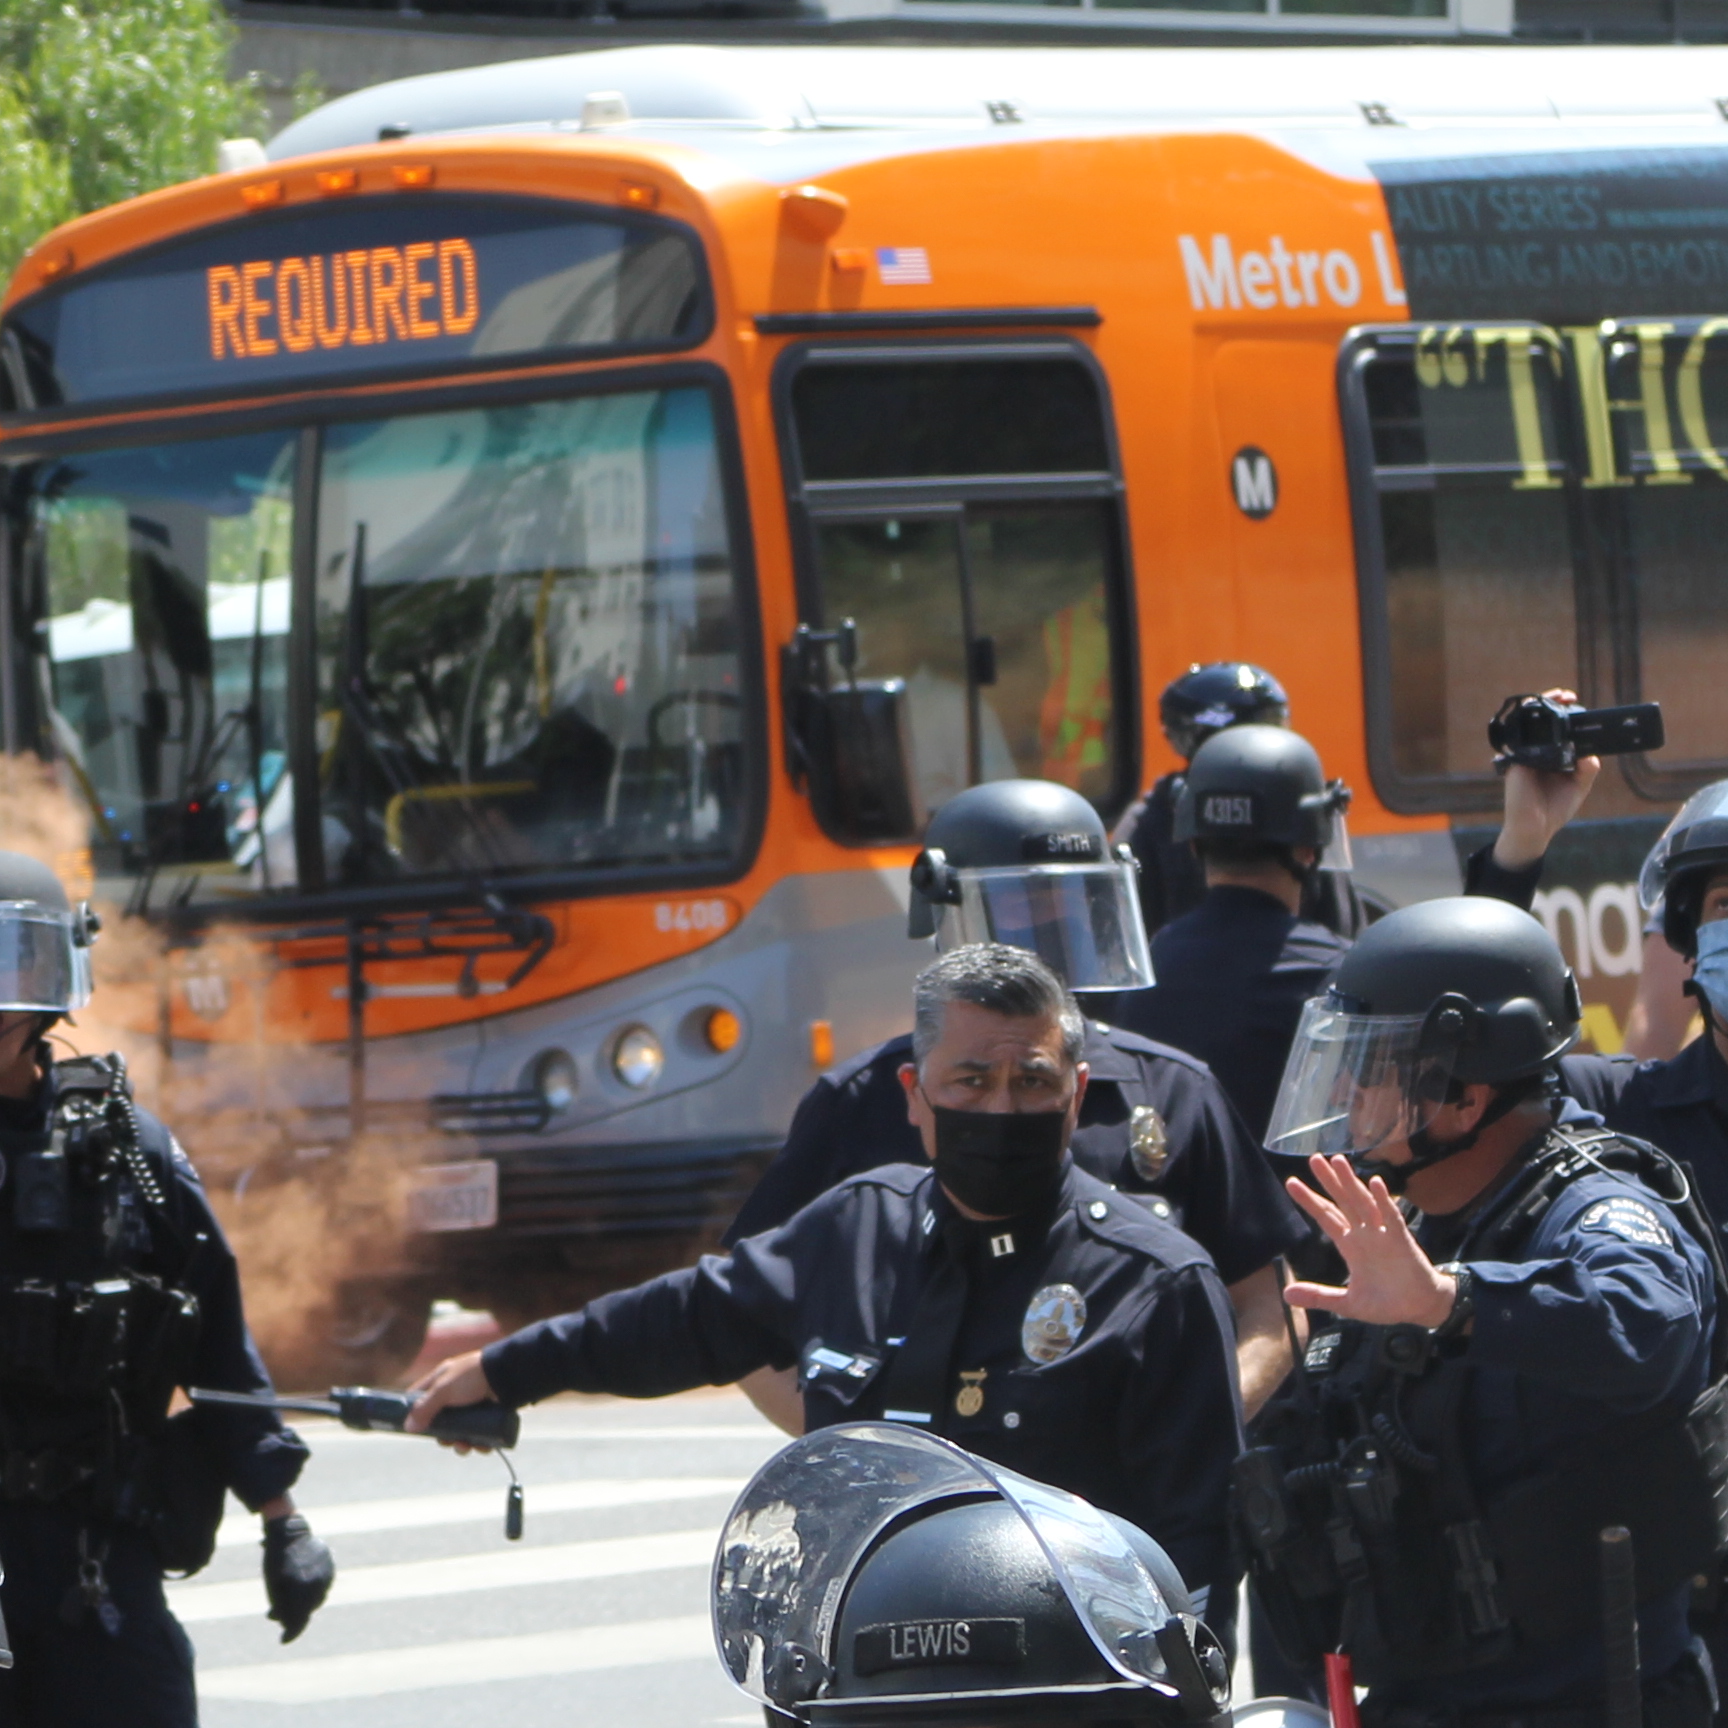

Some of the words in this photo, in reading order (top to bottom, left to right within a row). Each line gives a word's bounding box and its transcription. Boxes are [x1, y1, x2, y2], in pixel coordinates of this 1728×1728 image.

[207, 238, 479, 360] REQUIRED
[1179, 234, 1360, 311] Metro
[1235, 456, 1274, 512] M
[1047, 833, 1091, 852] SMITH
[889, 1621, 971, 1661] LEWIS
